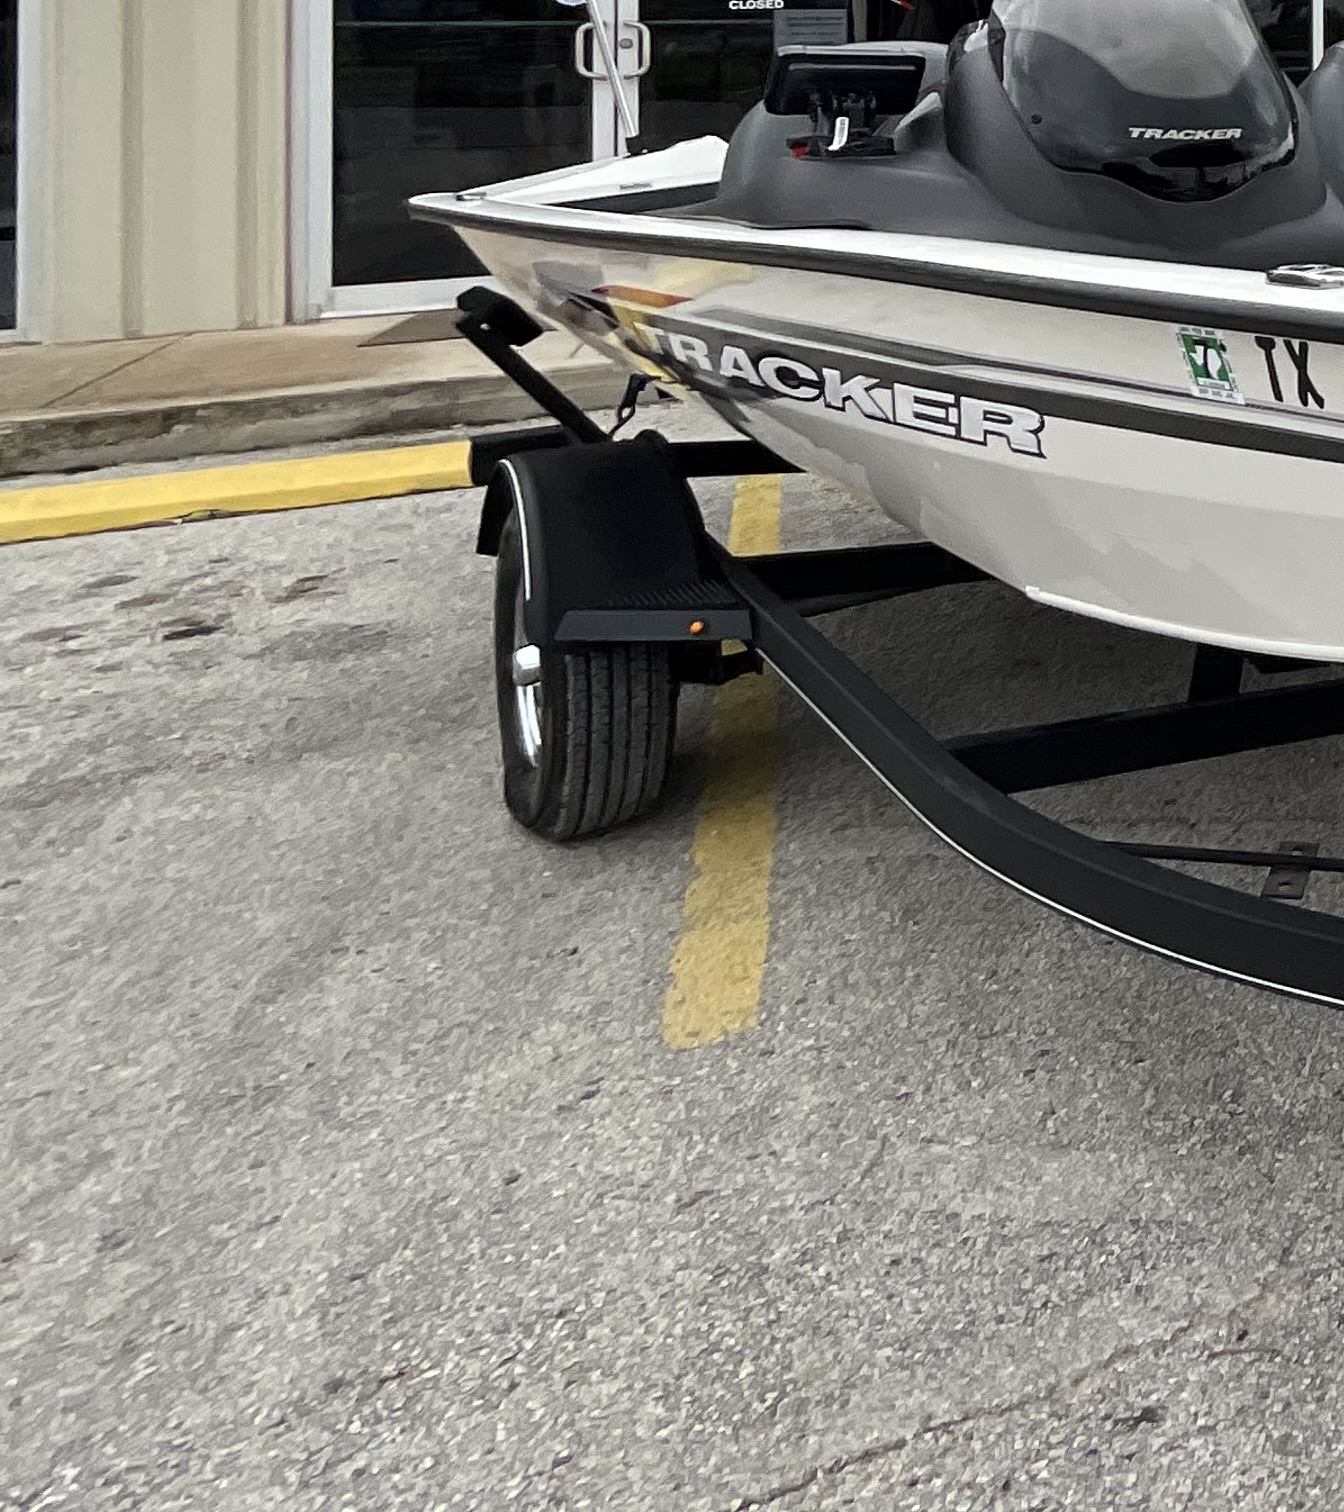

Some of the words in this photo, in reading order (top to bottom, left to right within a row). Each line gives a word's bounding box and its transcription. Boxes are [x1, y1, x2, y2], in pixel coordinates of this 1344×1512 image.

[729, 0, 784, 9] CLOSED
[1128, 127, 1243, 140] TRACKER
[634, 321, 1047, 459] TRACKER
[1255, 336, 1325, 409] TX
